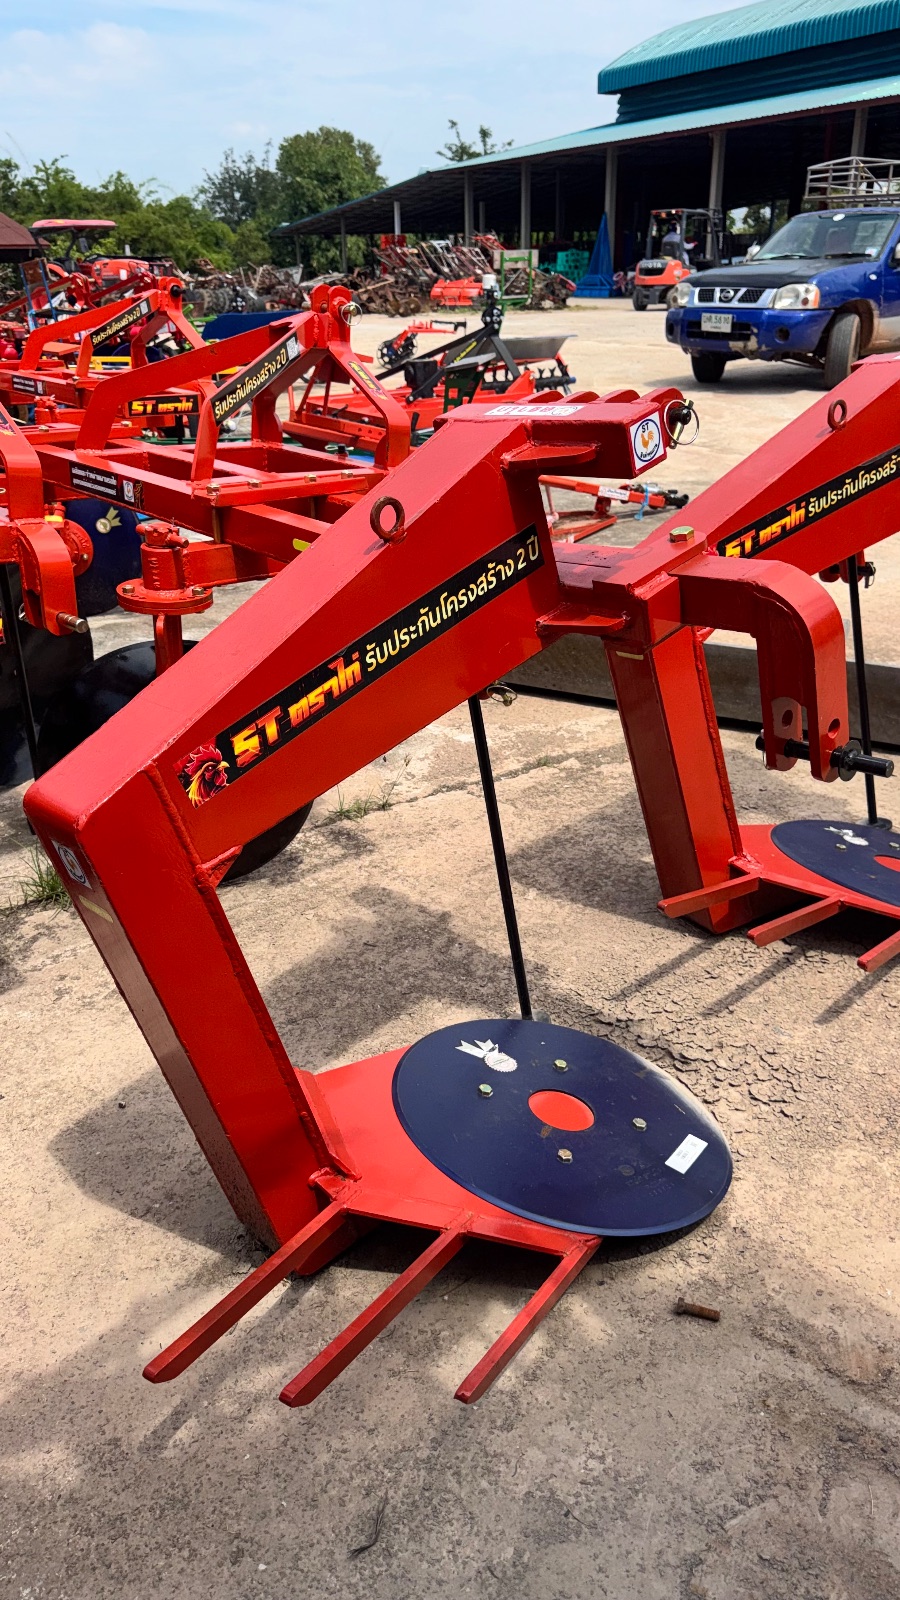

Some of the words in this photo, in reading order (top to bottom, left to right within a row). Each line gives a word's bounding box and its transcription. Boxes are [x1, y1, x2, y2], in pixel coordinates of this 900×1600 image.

[131, 399, 156, 414] ST
[214, 361, 277, 420] รับประกันโครงสร้าง
[276, 355, 282, 369] 2
[280, 347, 287, 365] ปี
[641, 421, 650, 433] ST
[724, 529, 756, 559] ST
[759, 501, 806, 546] ตราไก่
[229, 703, 285, 769] ST
[287, 651, 364, 730] ตราไก่
[365, 557, 516, 673] รับประกันโครงสร้าง
[515, 546, 527, 571] 2
[525, 534, 540, 565] ปี
